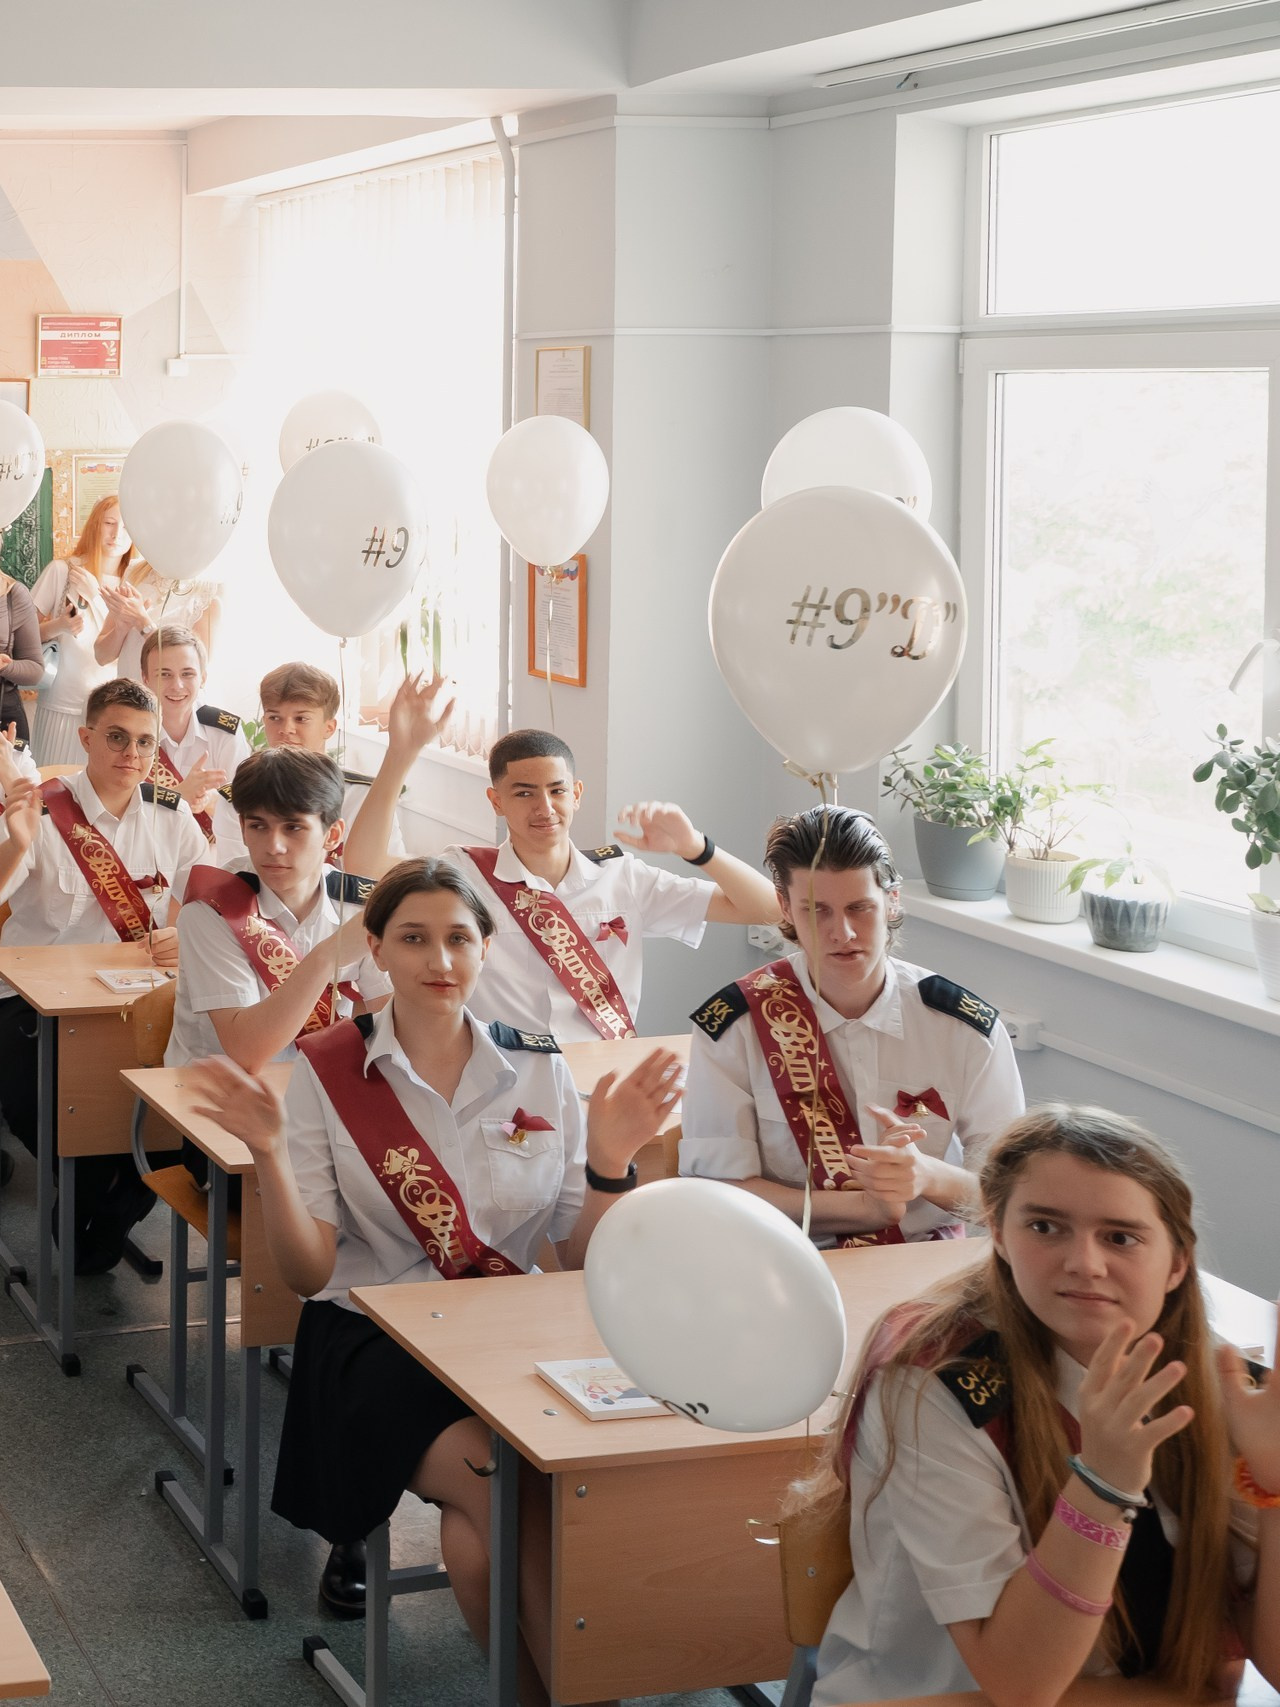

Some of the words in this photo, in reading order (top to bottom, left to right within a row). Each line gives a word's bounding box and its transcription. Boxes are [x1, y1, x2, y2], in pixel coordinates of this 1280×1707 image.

[708, 998, 734, 1022] КК
[958, 993, 980, 1018] КК
[975, 1003, 996, 1029] 33
[696, 1008, 723, 1033] 33
[957, 1371, 991, 1406] 33
